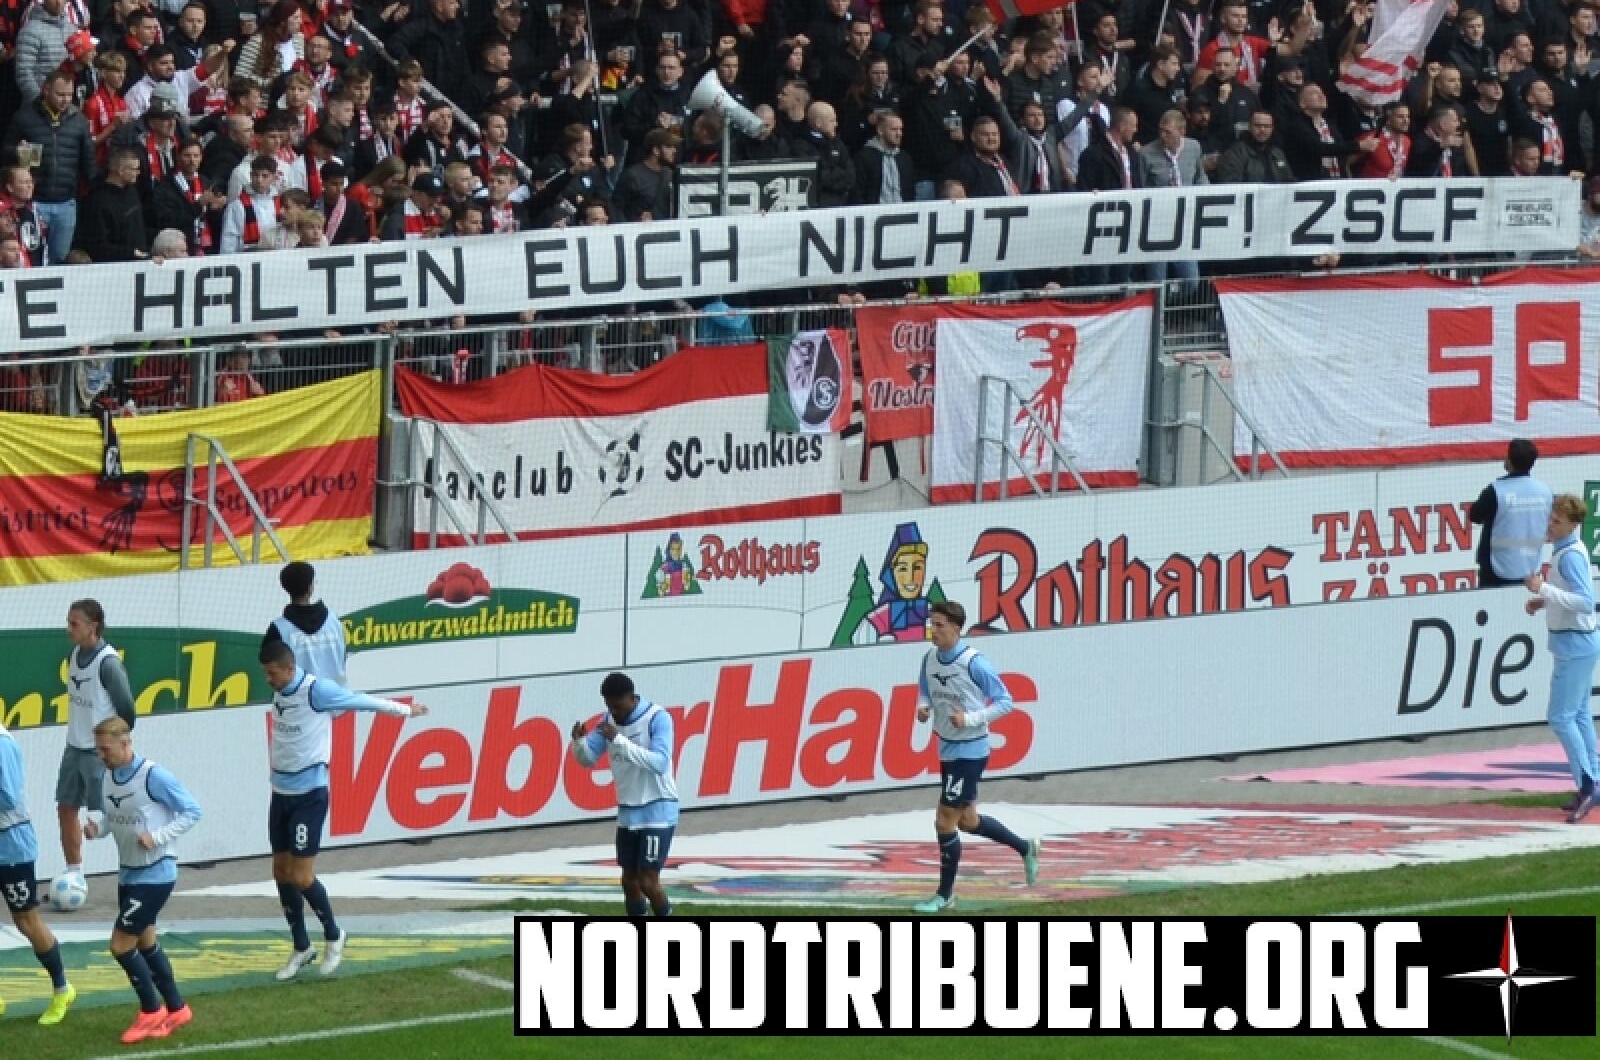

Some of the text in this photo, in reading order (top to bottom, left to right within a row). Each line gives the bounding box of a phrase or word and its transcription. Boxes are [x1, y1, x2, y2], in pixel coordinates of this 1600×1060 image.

[133, 246, 465, 333] HALTEN
[524, 225, 739, 300] EUCH
[799, 206, 1029, 278] NICHT
[1082, 192, 1255, 257] AUF!
[1290, 186, 1484, 245] ZSCF
[1427, 301, 1600, 428] SP
[664, 430, 824, 482] SC-Junkies
[1311, 501, 1473, 563] TANN
[699, 532, 822, 585] Rothaus
[965, 526, 1295, 638] Rothaus
[342, 599, 574, 646] Schwarzwaldmilch
[1397, 609, 1535, 715] Die
[945, 774, 965, 796] 14
[295, 823, 309, 846] 8
[4, 881, 30, 904] 33
[122, 898, 143, 921] 7
